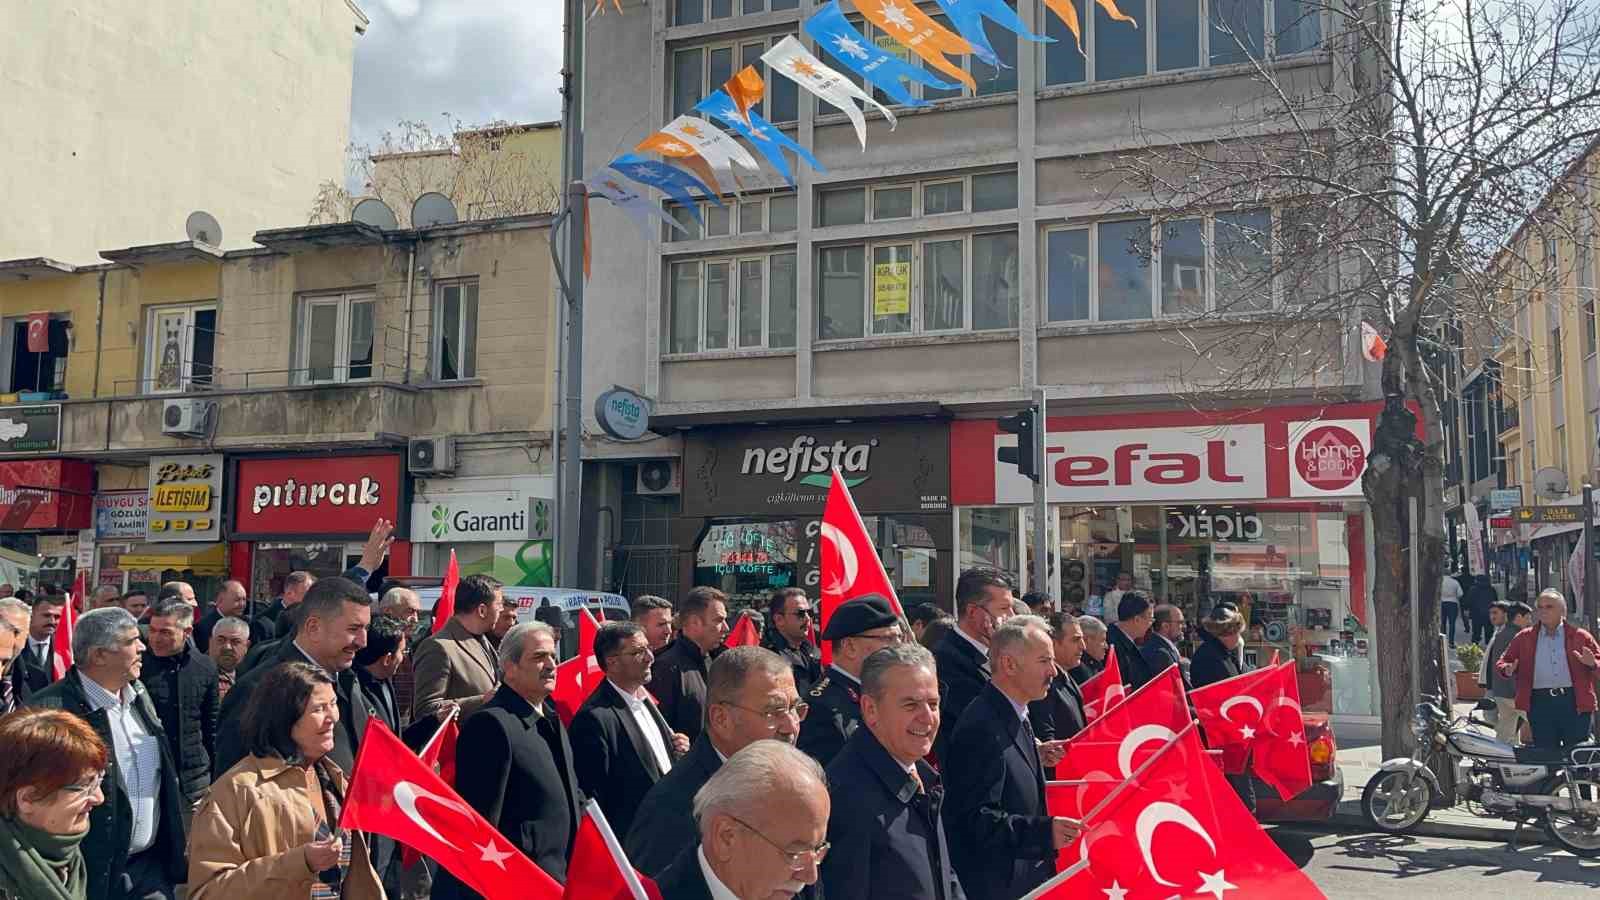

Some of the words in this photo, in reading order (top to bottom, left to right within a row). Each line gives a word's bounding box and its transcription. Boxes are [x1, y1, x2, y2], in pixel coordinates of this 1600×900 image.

[741, 436, 870, 482] nefista
[1302, 441, 1361, 459] Home
[1307, 461, 1317, 471] &
[156, 487, 207, 506] İLETİŞİM
[253, 477, 379, 514] pıtırcık
[453, 510, 524, 532] Garanti
